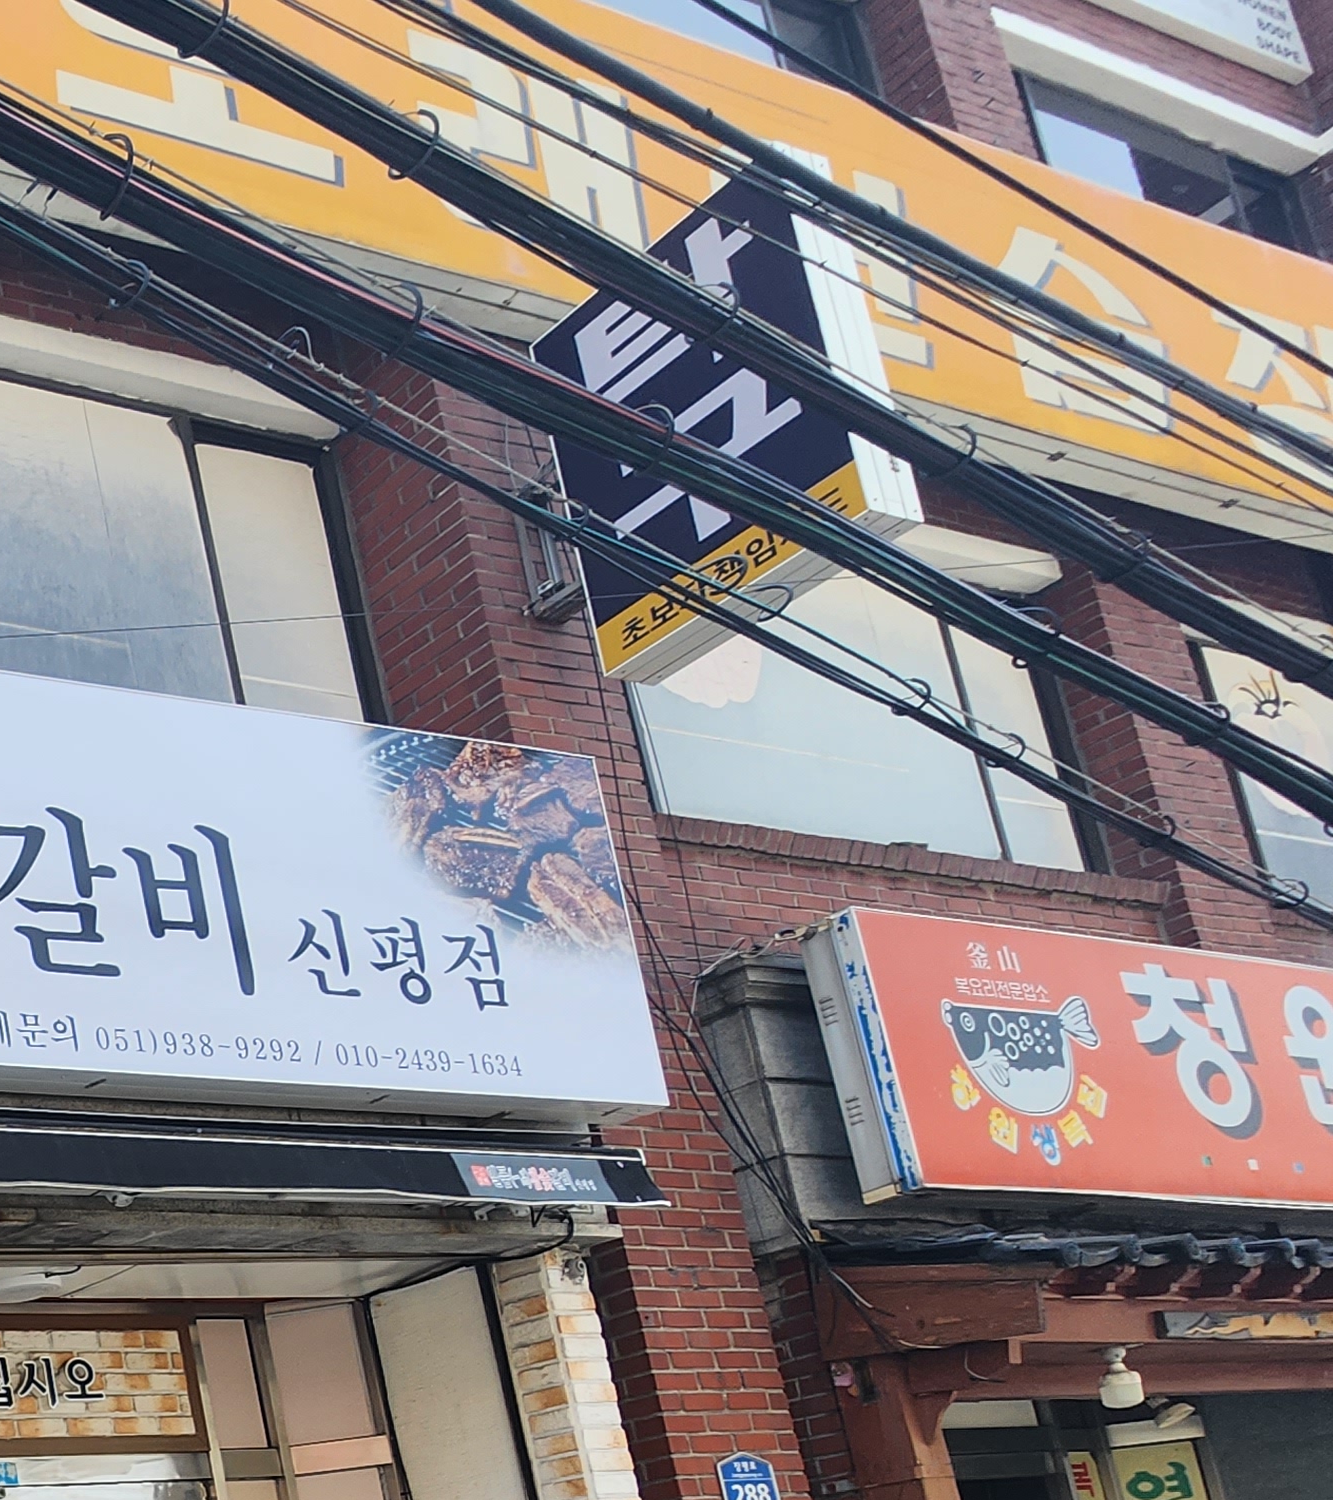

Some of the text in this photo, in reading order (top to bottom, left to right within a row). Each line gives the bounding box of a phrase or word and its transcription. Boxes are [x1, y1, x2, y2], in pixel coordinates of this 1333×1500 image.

[1256, 36, 1301, 64] SHAPE
[287, 908, 512, 1012] 신평점
[966, 942, 1021, 973] 釜山
[954, 977, 1051, 1003] 복요리전문업소
[94, 1025, 303, 1065] 051)938-9292
[334, 1040, 525, 1078] 010-2439-1634
